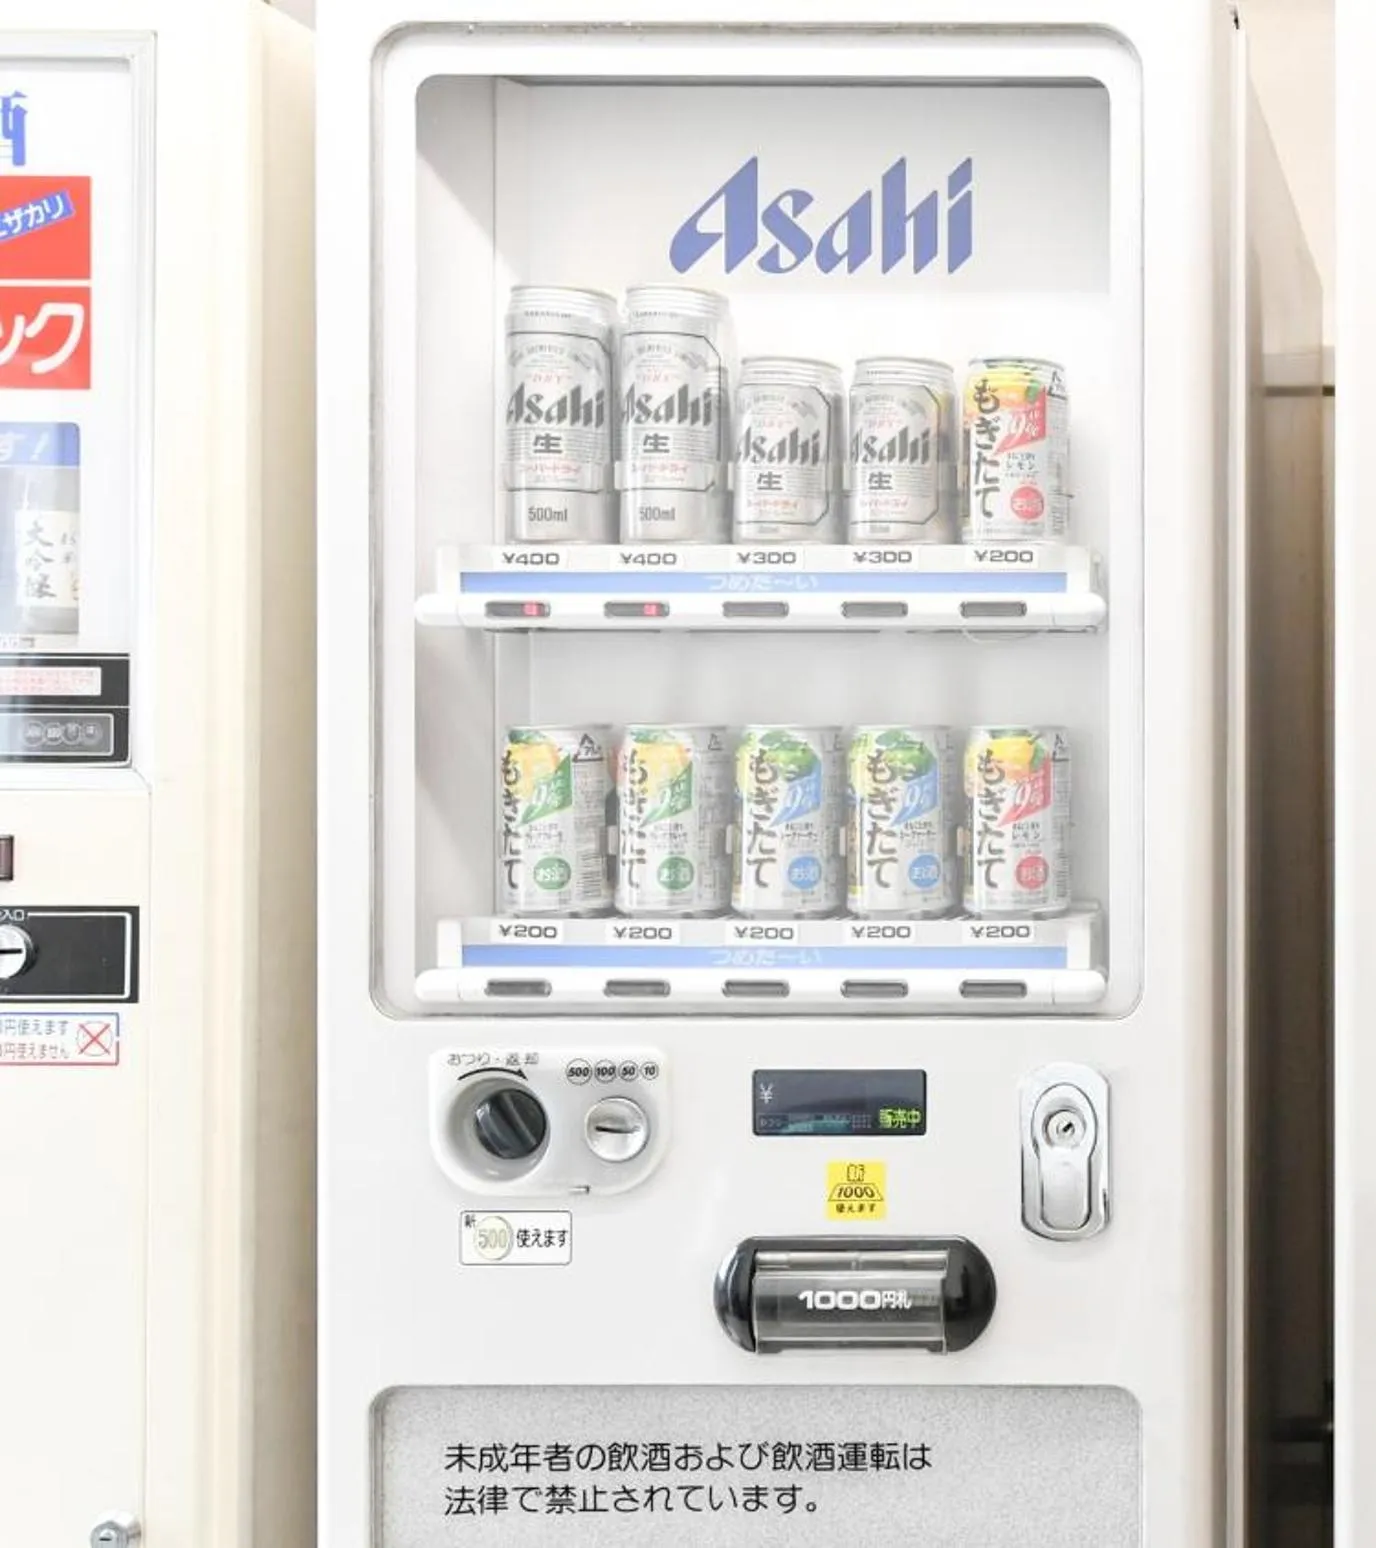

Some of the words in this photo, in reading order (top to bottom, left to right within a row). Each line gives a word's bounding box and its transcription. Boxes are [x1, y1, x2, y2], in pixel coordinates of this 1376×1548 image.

[669, 156, 972, 274] Asahi
[506, 382, 605, 428] Asahi
[621, 383, 715, 427] Asahi
[533, 433, 563, 454] 生
[643, 433, 670, 454] 生
[737, 426, 820, 465] Asahi
[973, 379, 1001, 518] もぎたて
[757, 471, 783, 491] 生
[868, 471, 893, 491] 生
[528, 506, 568, 523] 500ml
[639, 506, 676, 522] 500ml
[502, 552, 560, 566] ¥400
[620, 552, 678, 566] ¥400
[737, 551, 797, 565] ¥300
[853, 550, 913, 564] ¥300
[974, 550, 1034, 563] ¥200
[746, 749, 779, 889] もぎたて
[866, 749, 899, 889] もぎたて
[976, 748, 1006, 889] もぎたて
[499, 924, 558, 940] ¥200
[613, 925, 673, 940] ¥200
[734, 925, 795, 940] ¥200
[852, 925, 912, 939] ¥200
[970, 925, 1030, 939] ¥200
[0, 1018, 69, 1036] 円使えます
[0, 1042, 70, 1060] 円使えません
[567, 1066, 590, 1078] 500
[596, 1065, 615, 1077] 100
[621, 1066, 636, 1077] 50
[644, 1065, 656, 1076] 10
[760, 1083, 773, 1104] ¥
[878, 1108, 921, 1129] 販売中
[837, 1186, 875, 1199] 1000
[477, 1228, 508, 1250] 500
[516, 1228, 569, 1249] 使えます
[798, 1289, 912, 1310] 1000円札
[444, 1441, 933, 1474] 未成年者の飲酒および飲酒運転は
[444, 1484, 818, 1516] 法律で禁止されています。
